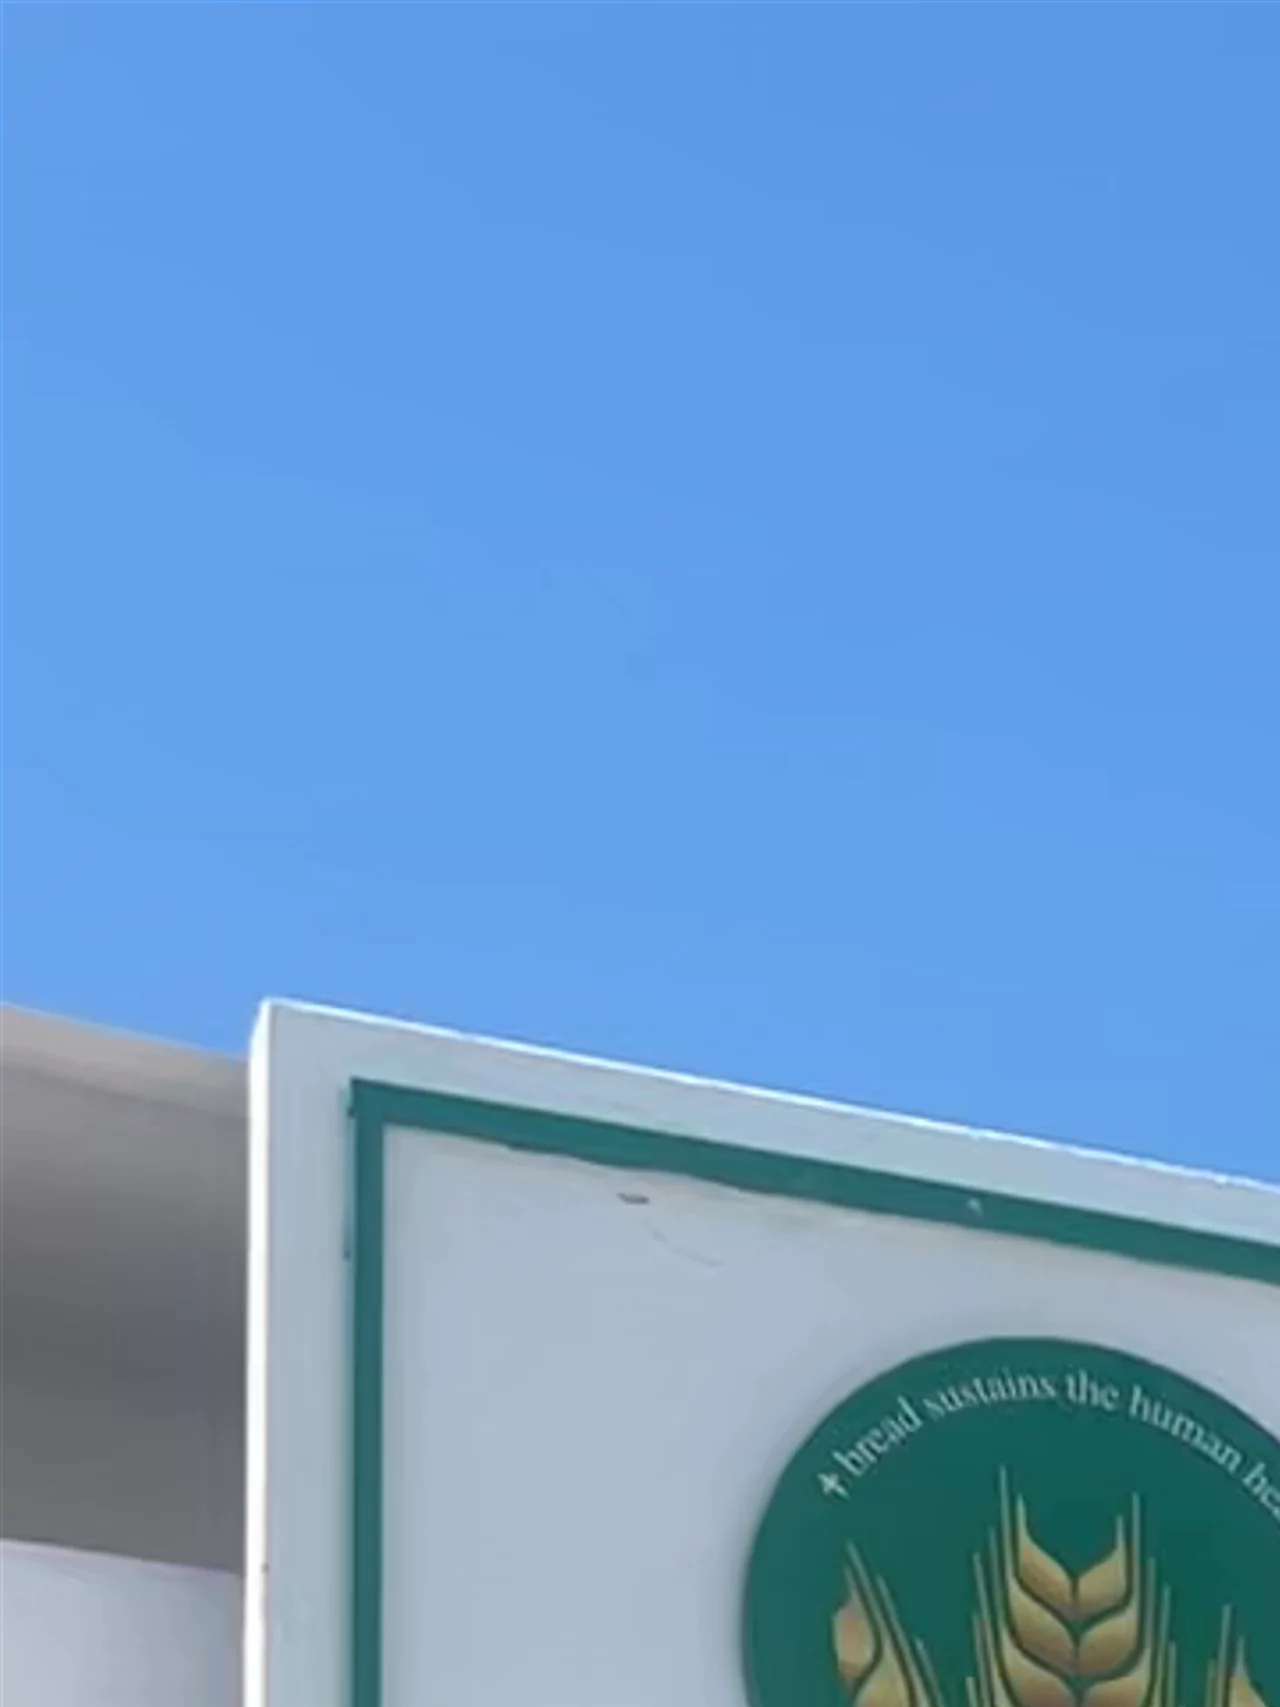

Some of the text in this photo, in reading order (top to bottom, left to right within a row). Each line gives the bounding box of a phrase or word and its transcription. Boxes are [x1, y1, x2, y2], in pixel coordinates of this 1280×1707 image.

[832, 1395, 923, 1477] bread
[922, 1366, 1056, 1421] sustains
[1065, 1368, 1119, 1412] the
[1128, 1384, 1244, 1475] human
